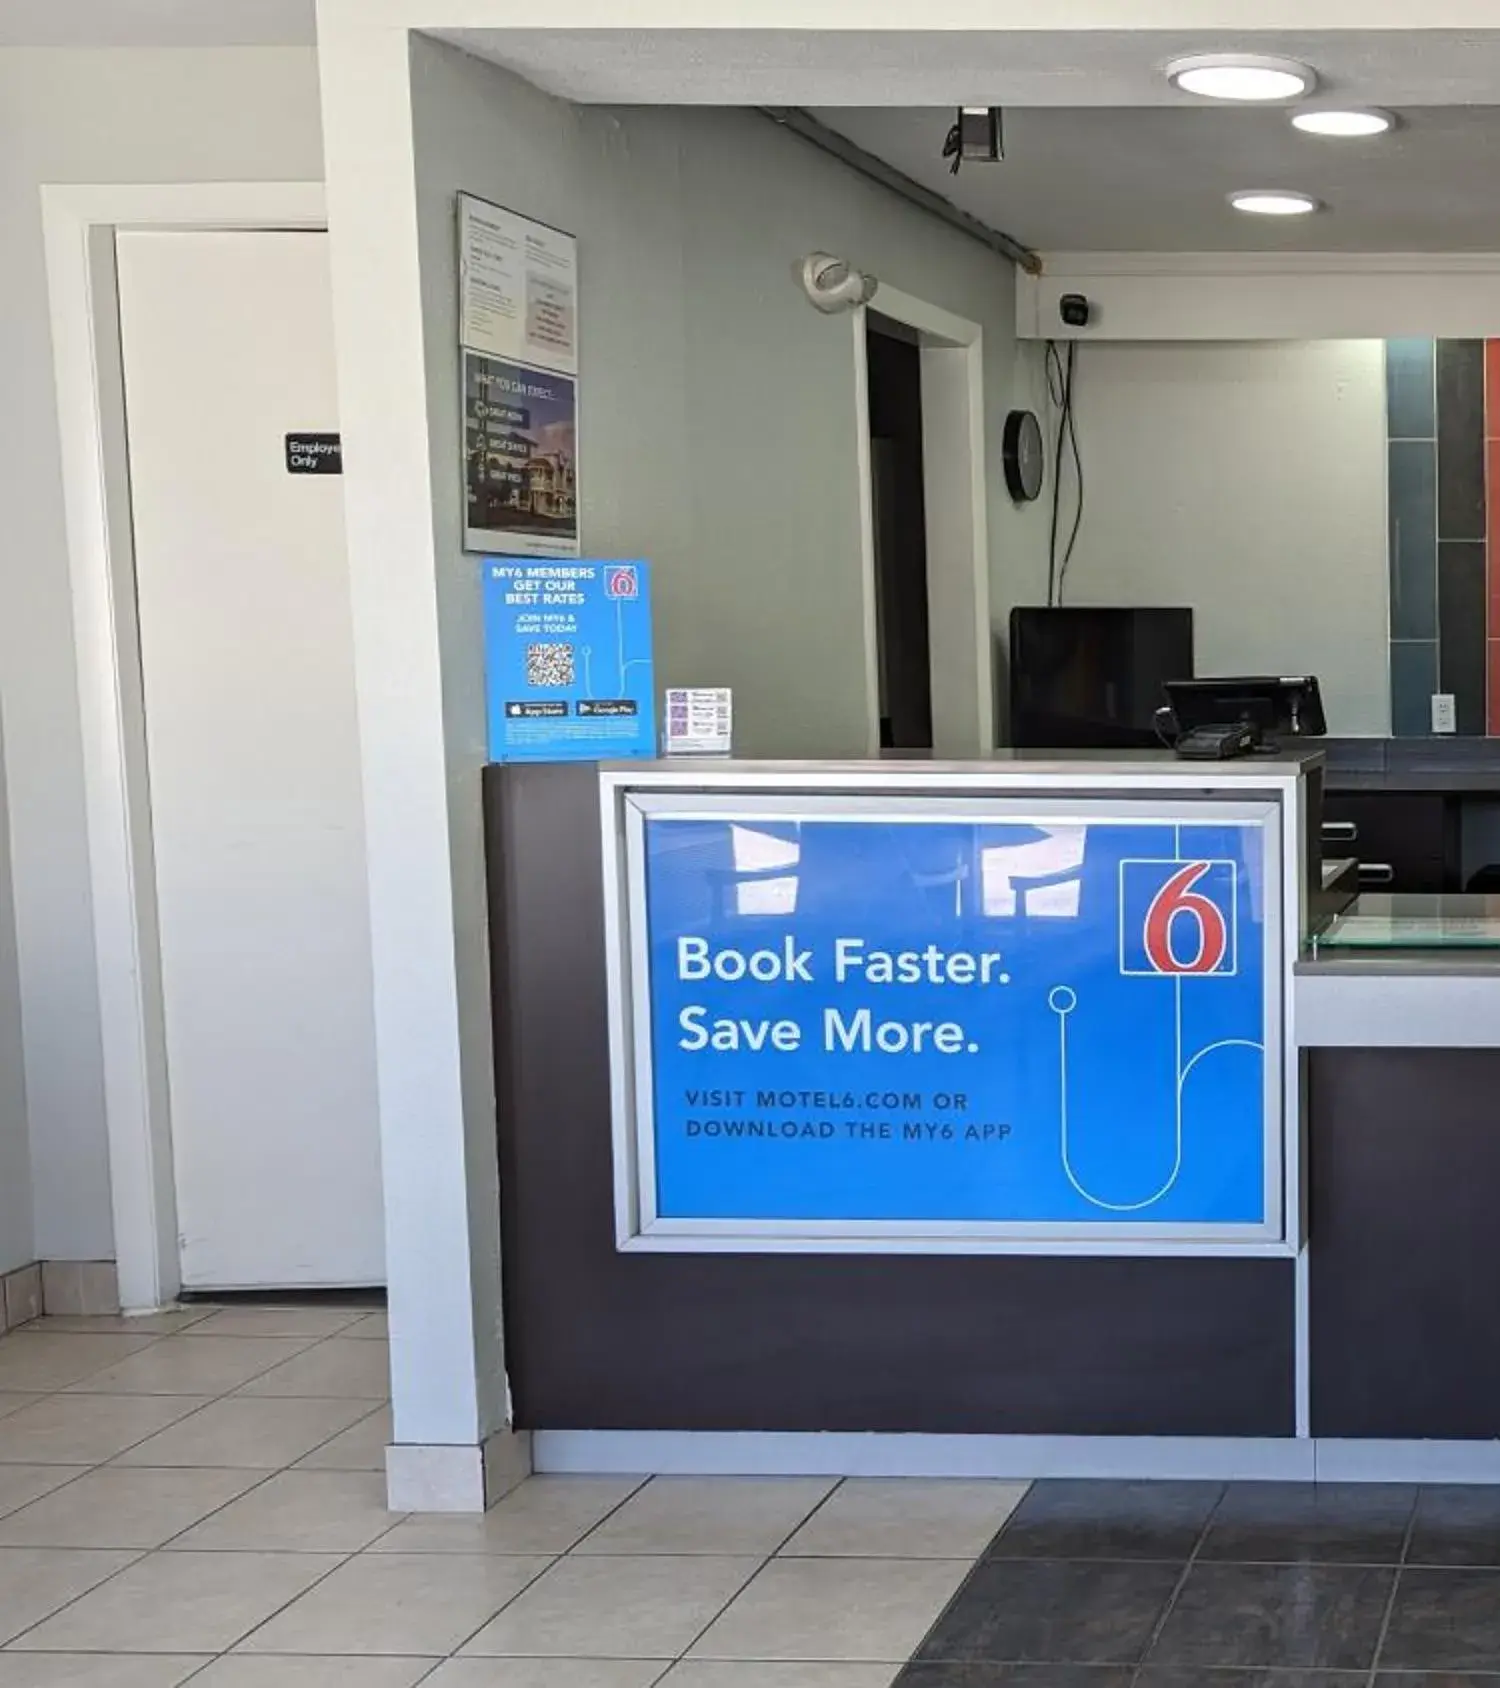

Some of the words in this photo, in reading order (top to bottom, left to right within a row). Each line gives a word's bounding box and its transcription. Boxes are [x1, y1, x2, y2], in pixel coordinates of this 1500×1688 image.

[291, 455, 318, 469] Only
[492, 567, 522, 578] MY6
[527, 567, 595, 579] MEMBERS
[514, 580, 539, 591] GET
[546, 580, 576, 591] OUR
[505, 593, 538, 605] BEST
[544, 593, 584, 605] RATES
[516, 614, 541, 623] JOIN
[515, 624, 541, 633] SAVE
[545, 624, 576, 633] TODAY
[1144, 860, 1226, 975] 6
[677, 935, 814, 982] Book
[835, 938, 1011, 985] Faster.
[678, 1005, 801, 1052] Save
[823, 1007, 979, 1054] More.
[685, 1090, 745, 1108] VISIT
[757, 1091, 922, 1110] MOTEL6.COM
[933, 1093, 968, 1111] OR
[686, 1120, 835, 1139] DOWNLOAD
[846, 1121, 892, 1140] THE
[903, 1122, 953, 1141] MY6
[965, 1123, 1012, 1141] APP
